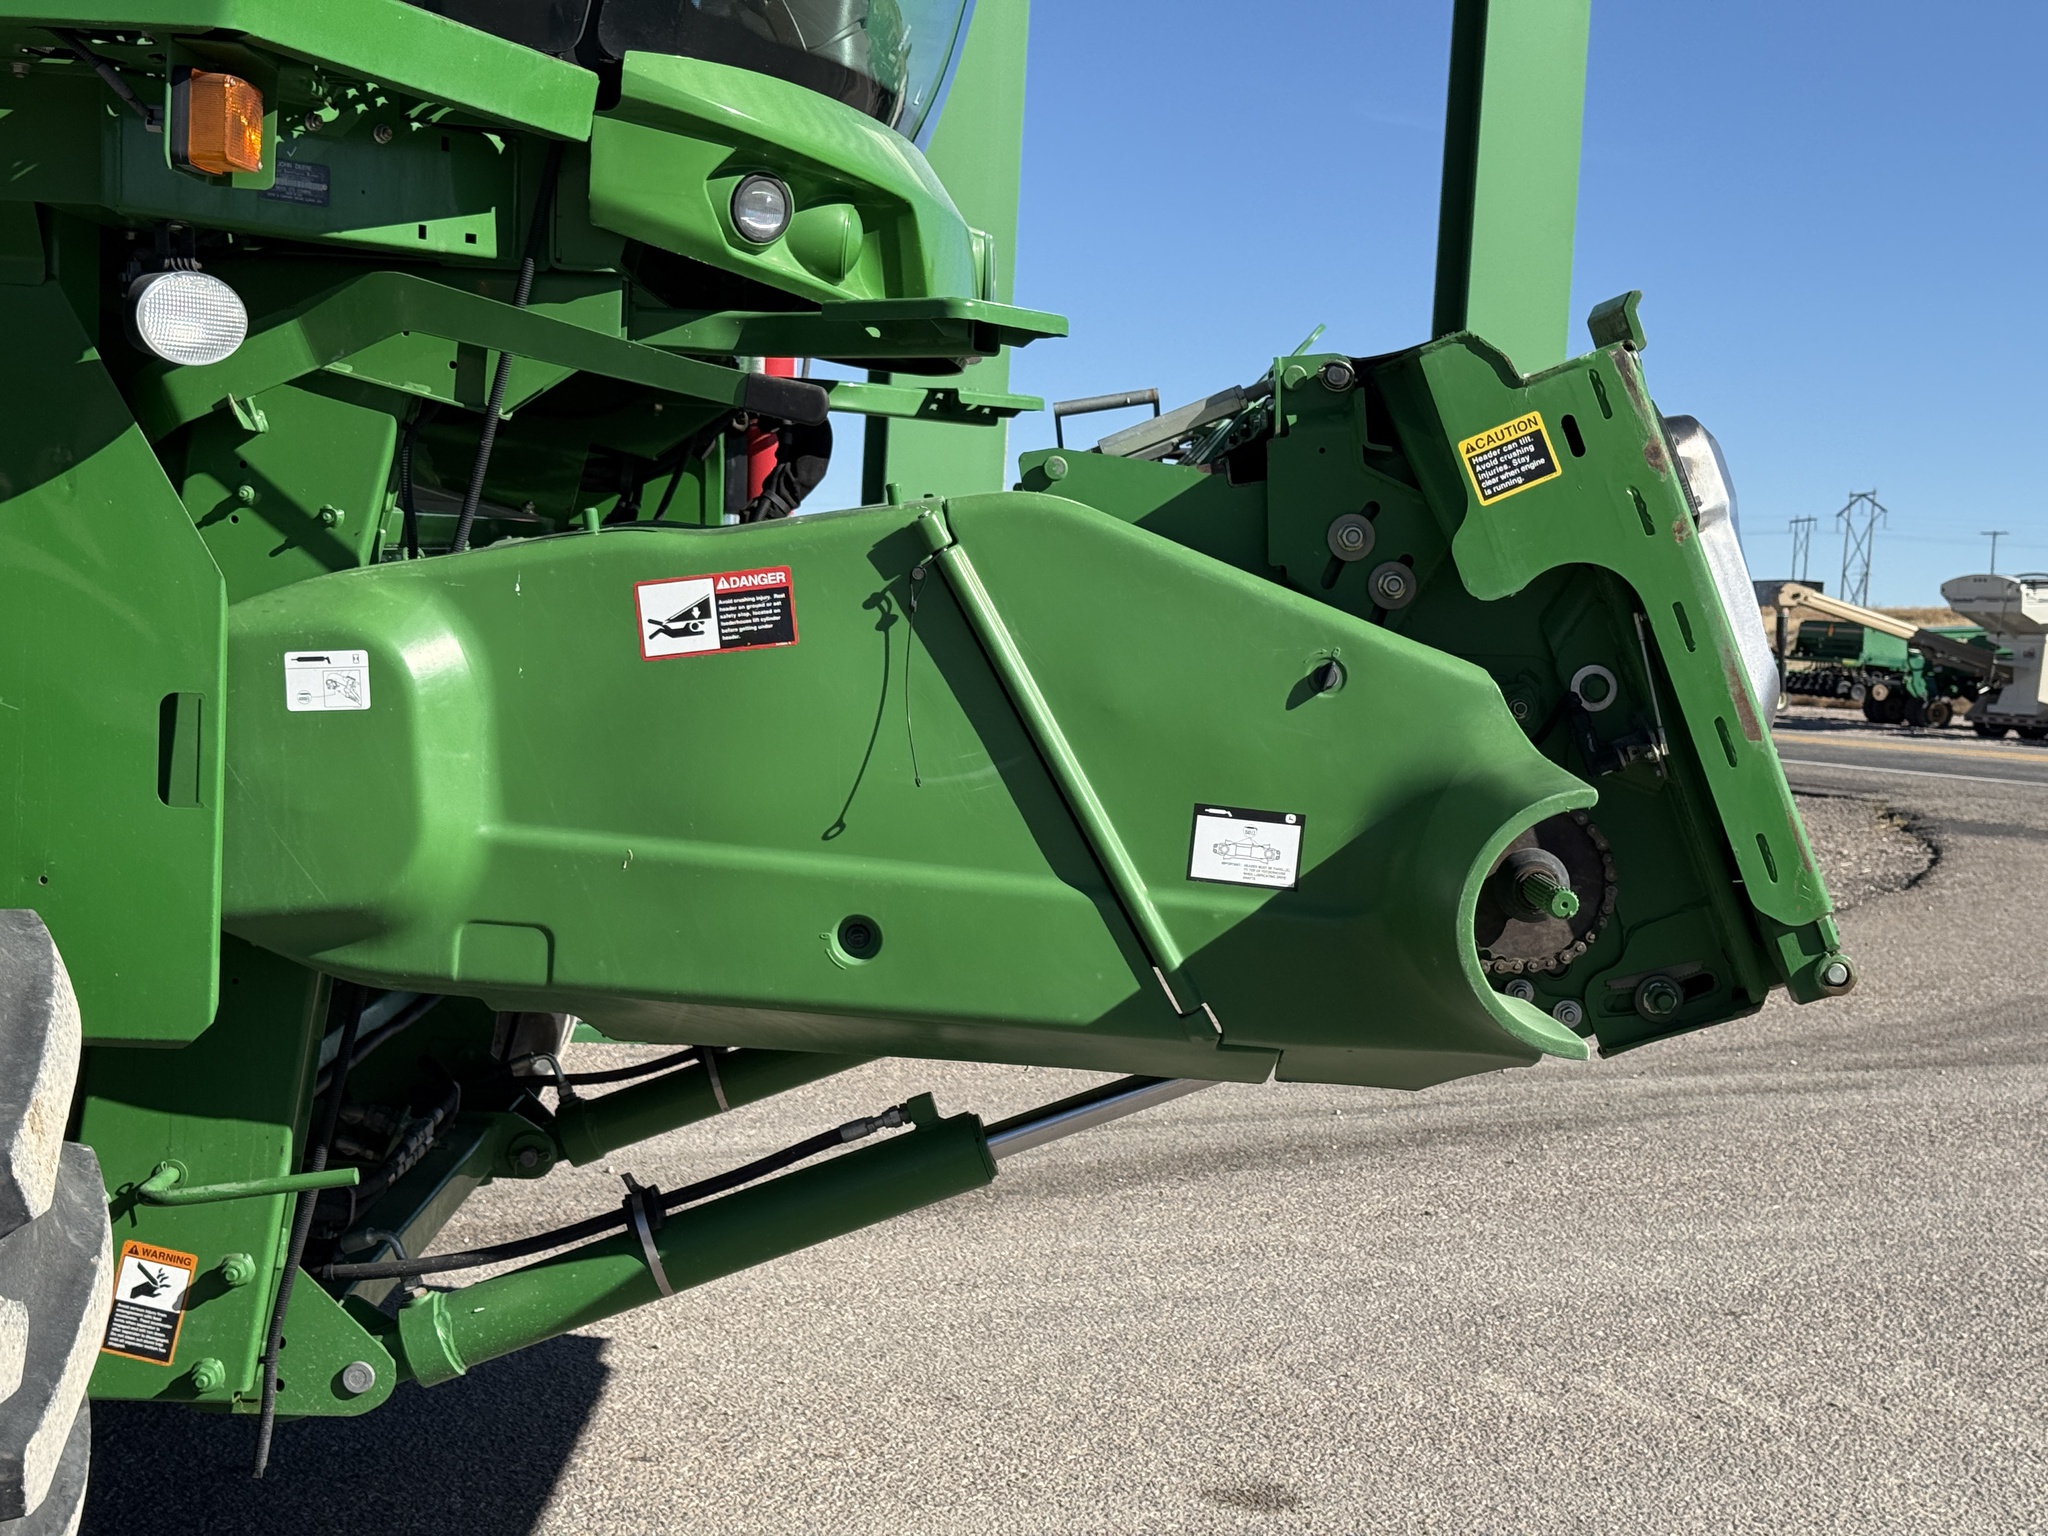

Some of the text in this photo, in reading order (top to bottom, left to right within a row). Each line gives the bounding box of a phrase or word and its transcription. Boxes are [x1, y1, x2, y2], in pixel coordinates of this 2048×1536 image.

[1476, 416, 1538, 449] CAUTION
[1472, 436, 1534, 464] Header can tilt.
[1476, 444, 1535, 472] Avoid crushing
[1478, 455, 1530, 480] injuries. Stay
[1481, 458, 1545, 488] clear when engine
[1493, 477, 1524, 492] running.
[730, 572, 786, 588] DANGER
[142, 1248, 192, 1266] WARNING
